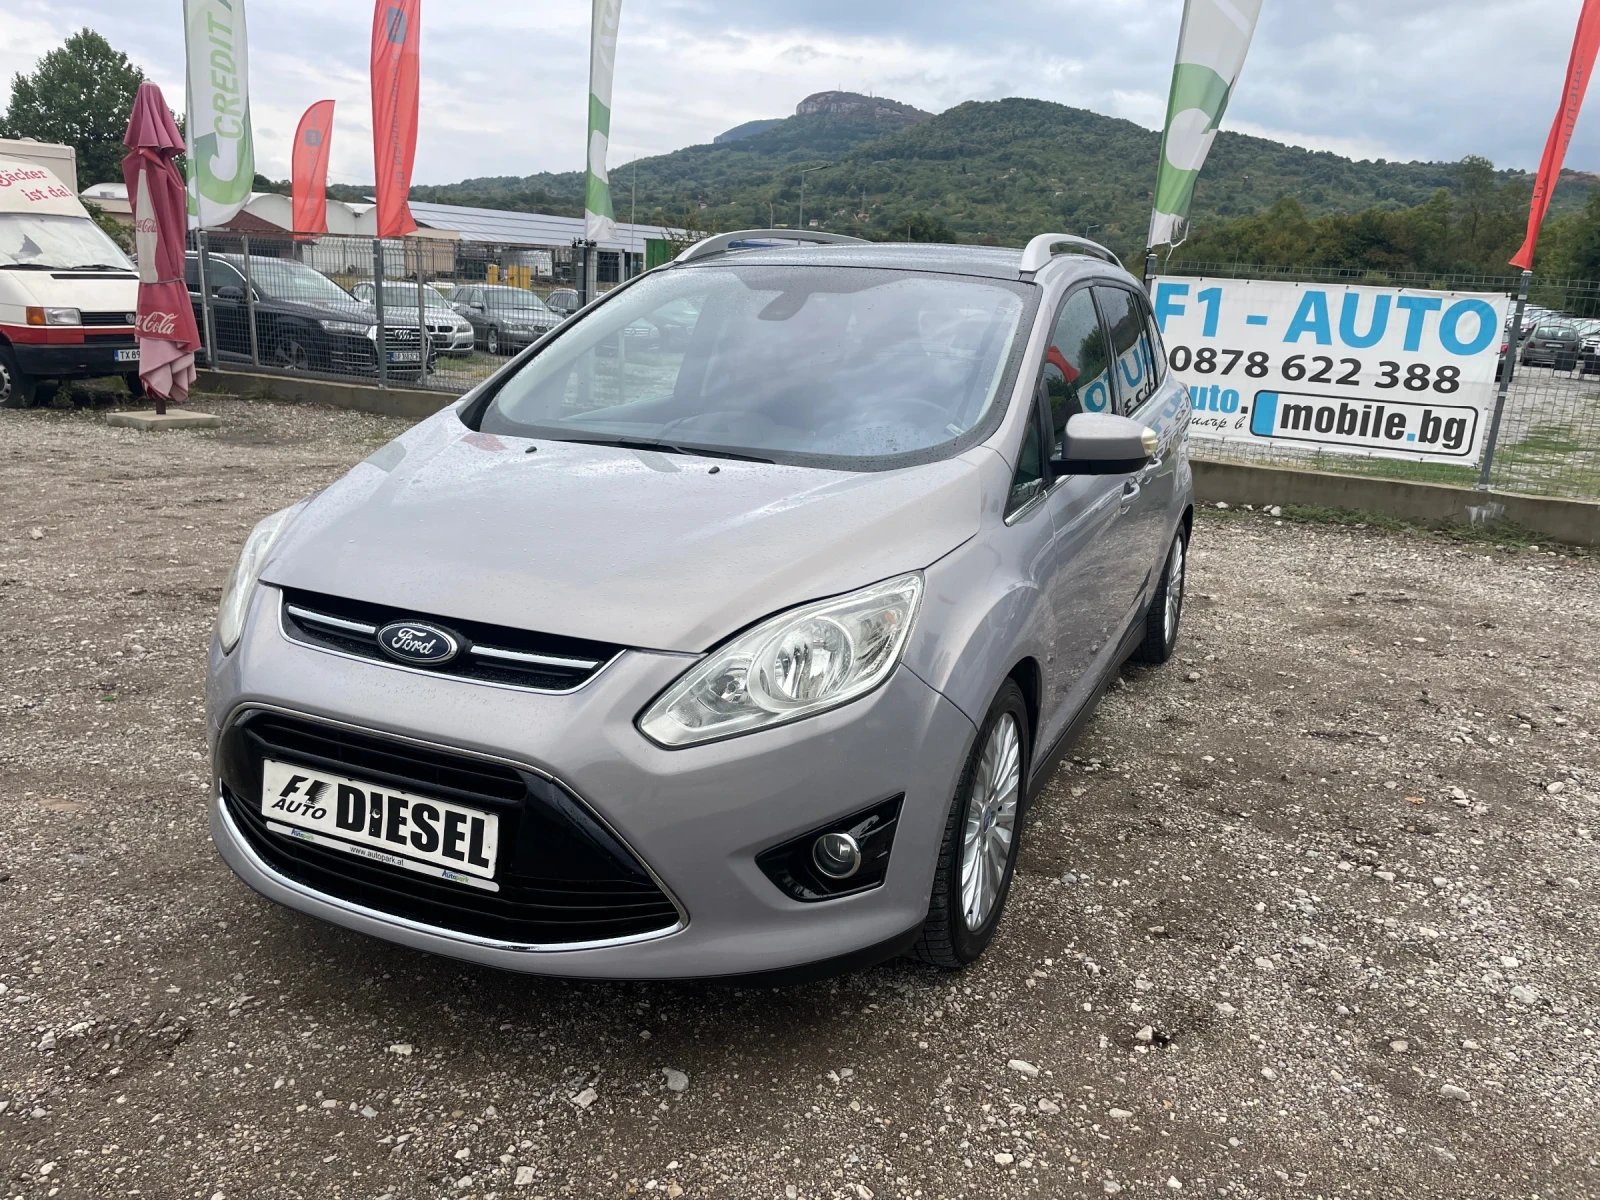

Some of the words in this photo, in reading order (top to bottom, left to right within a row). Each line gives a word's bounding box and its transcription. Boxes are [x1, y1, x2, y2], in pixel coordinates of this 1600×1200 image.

[207, 11, 244, 139] CREDIT
[20, 188, 49, 202] ist
[47, 184, 74, 198] da!
[1154, 282, 1224, 338] F1
[1283, 290, 1499, 356] AUTO
[1168, 345, 1269, 379] 0878
[1281, 354, 1361, 387] 622
[1374, 360, 1461, 394] 388
[1190, 384, 1248, 415] uto.
[1280, 402, 1467, 450] mobile.bg
[391, 627, 437, 655] Ford
[271, 798, 327, 820] AUTO
[336, 783, 490, 869] DIESEL
[350, 846, 404, 867] www.autopark.at
